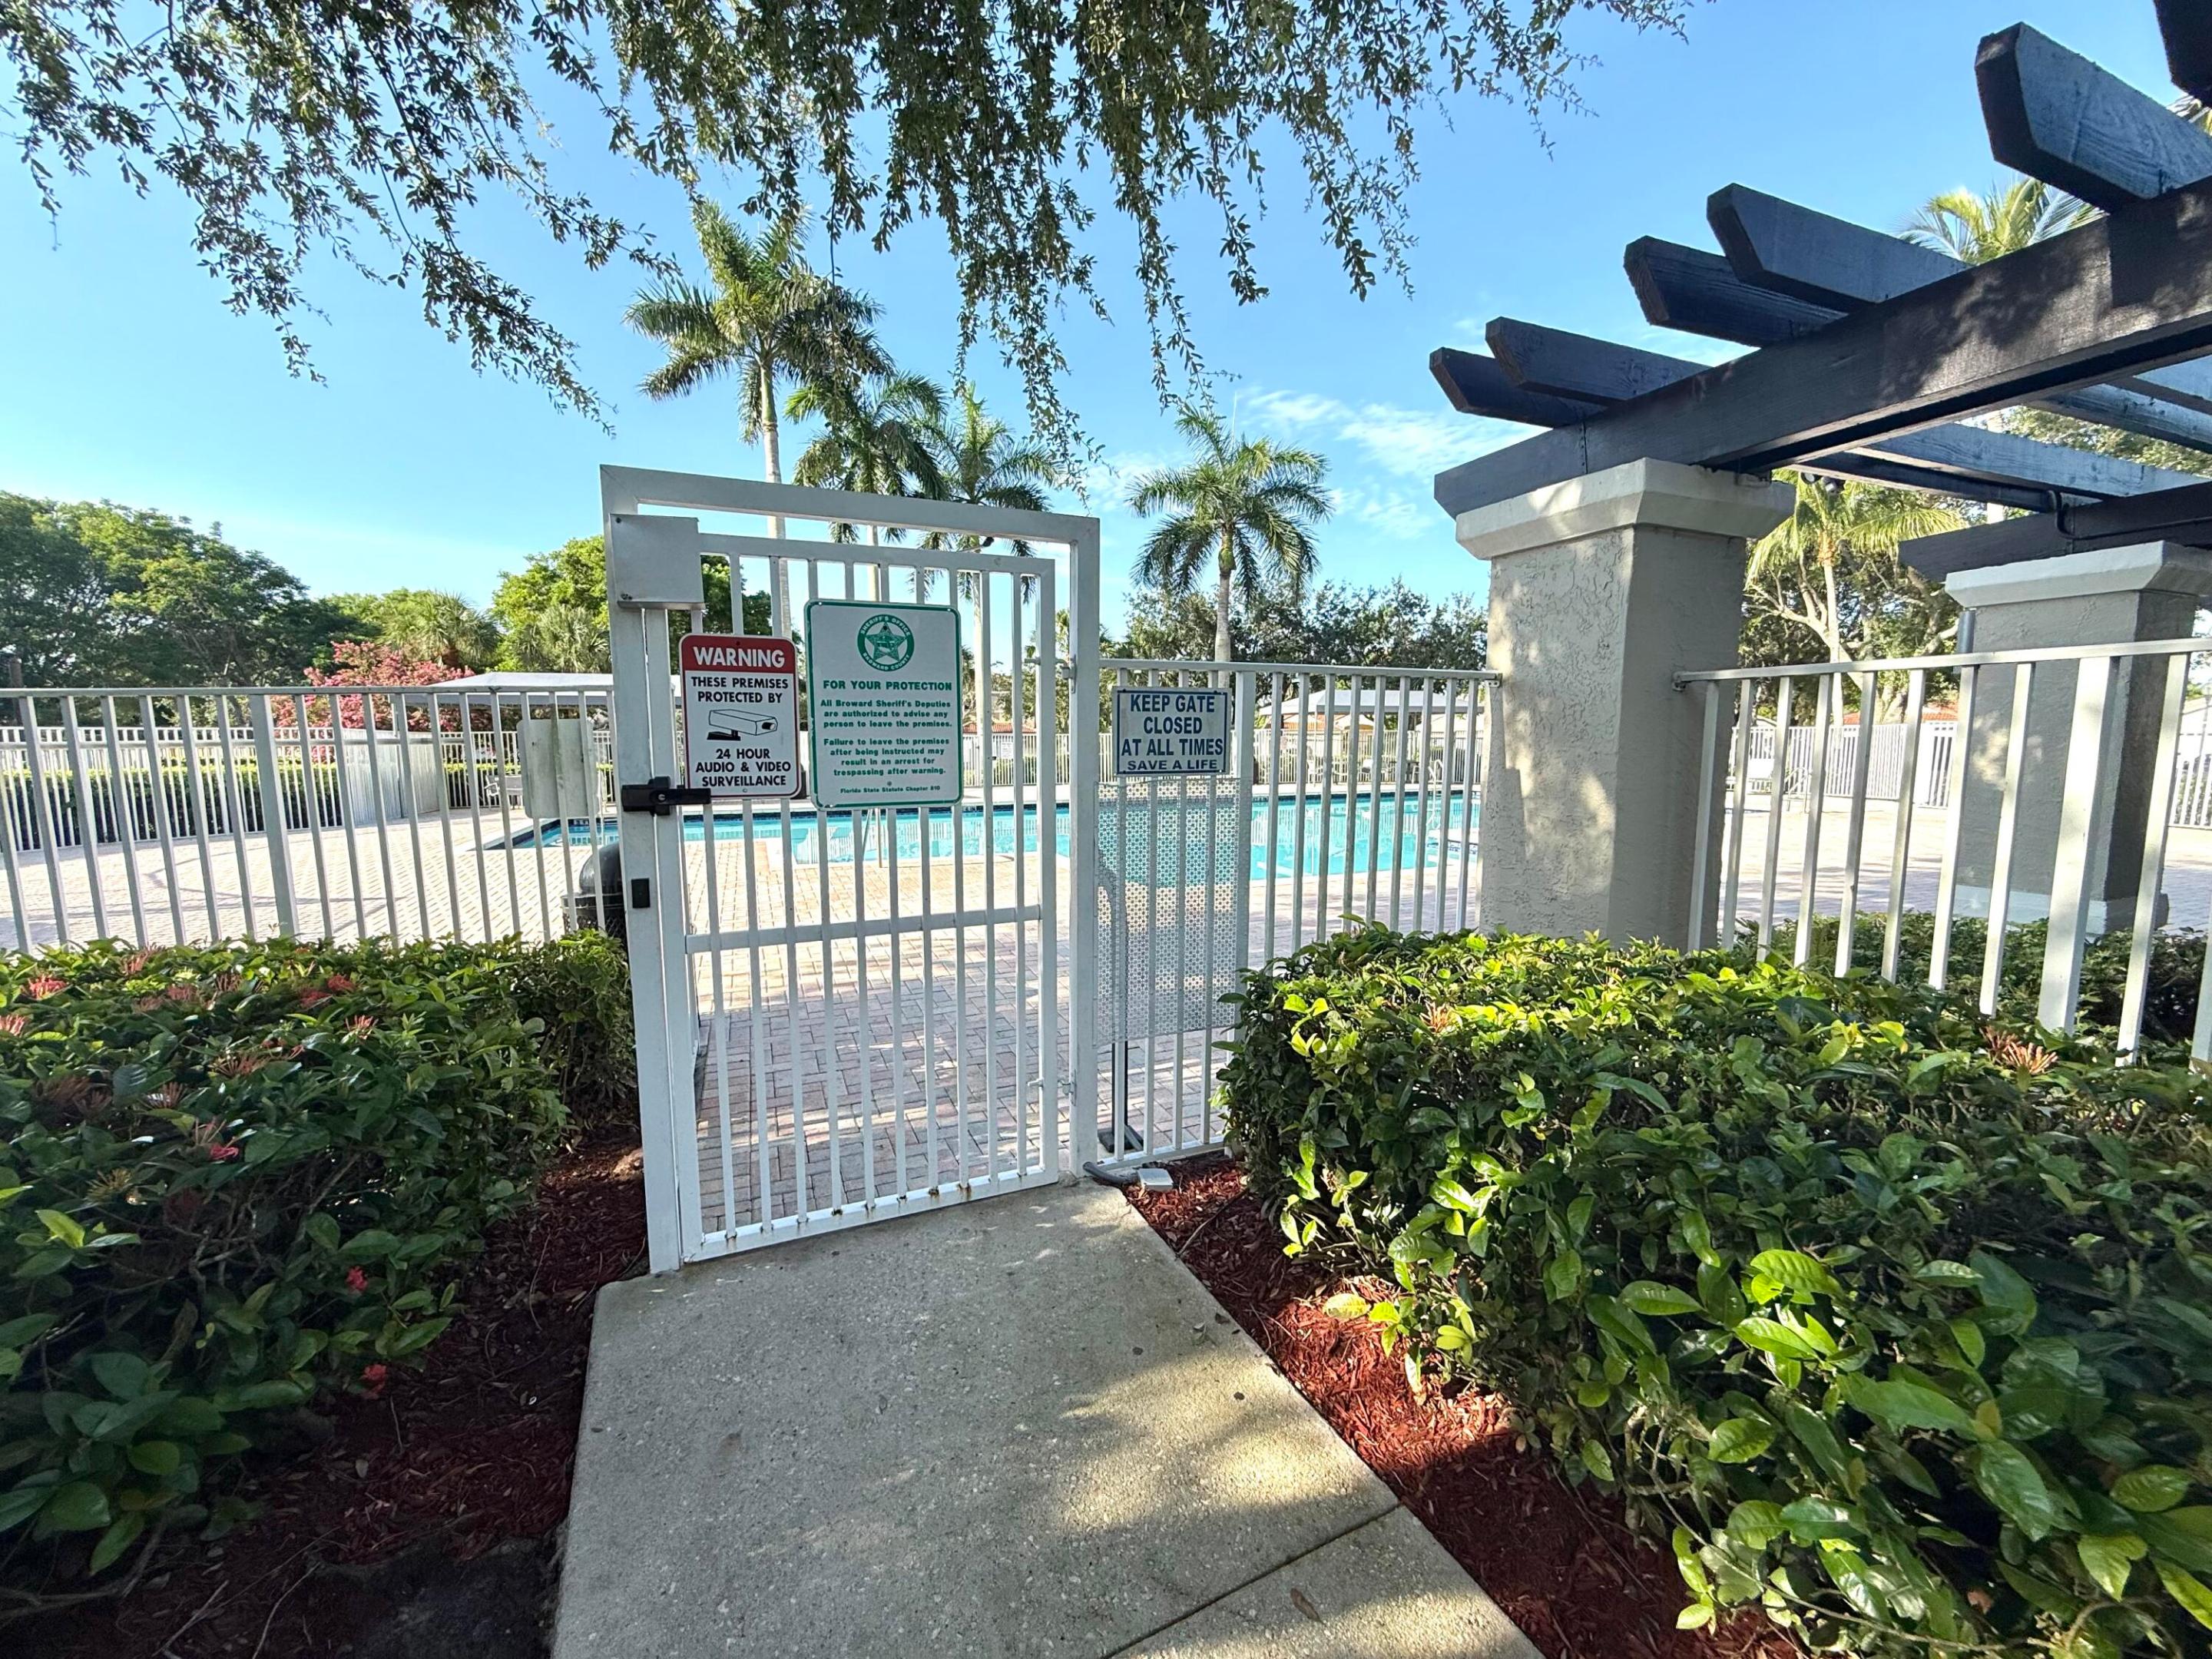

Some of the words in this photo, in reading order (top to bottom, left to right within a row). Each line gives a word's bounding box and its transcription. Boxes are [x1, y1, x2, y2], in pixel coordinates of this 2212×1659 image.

[892, 618, 911, 636] OFFICE
[693, 647, 785, 668] WARNING
[863, 652, 889, 670] BROWARD
[891, 654, 909, 670] COUNTY
[691, 677, 727, 687] THESE
[732, 677, 788, 689] PREMISES
[823, 680, 846, 689] FOR
[851, 680, 881, 690] YOUR
[886, 681, 952, 690] PROTECTION
[698, 692, 763, 703] PROTECTED
[768, 693, 783, 703] BY
[915, 700, 951, 708] Deputies
[1131, 694, 1170, 712] KEEP
[1175, 694, 1215, 713] GATE
[912, 720, 952, 728] premises.
[1144, 717, 1202, 734] CLOSED
[912, 737, 949, 746] premises
[1121, 739, 1141, 756] AT
[1147, 739, 1174, 756] ALL
[1179, 738, 1223, 756] TIMES
[716, 749, 730, 760] 24
[737, 749, 770, 759] HOUR
[856, 748, 879, 757] being
[696, 762, 734, 773] AUDIO
[741, 762, 750, 772] &
[756, 761, 791, 772] VIDEO
[1128, 760, 1167, 770] SAVE
[1172, 760, 1182, 770] A
[1187, 760, 1217, 770] LIFE
[834, 768, 884, 777] trespassing
[912, 767, 945, 775] warning.
[702, 776, 786, 787] SURVEILLANCE
